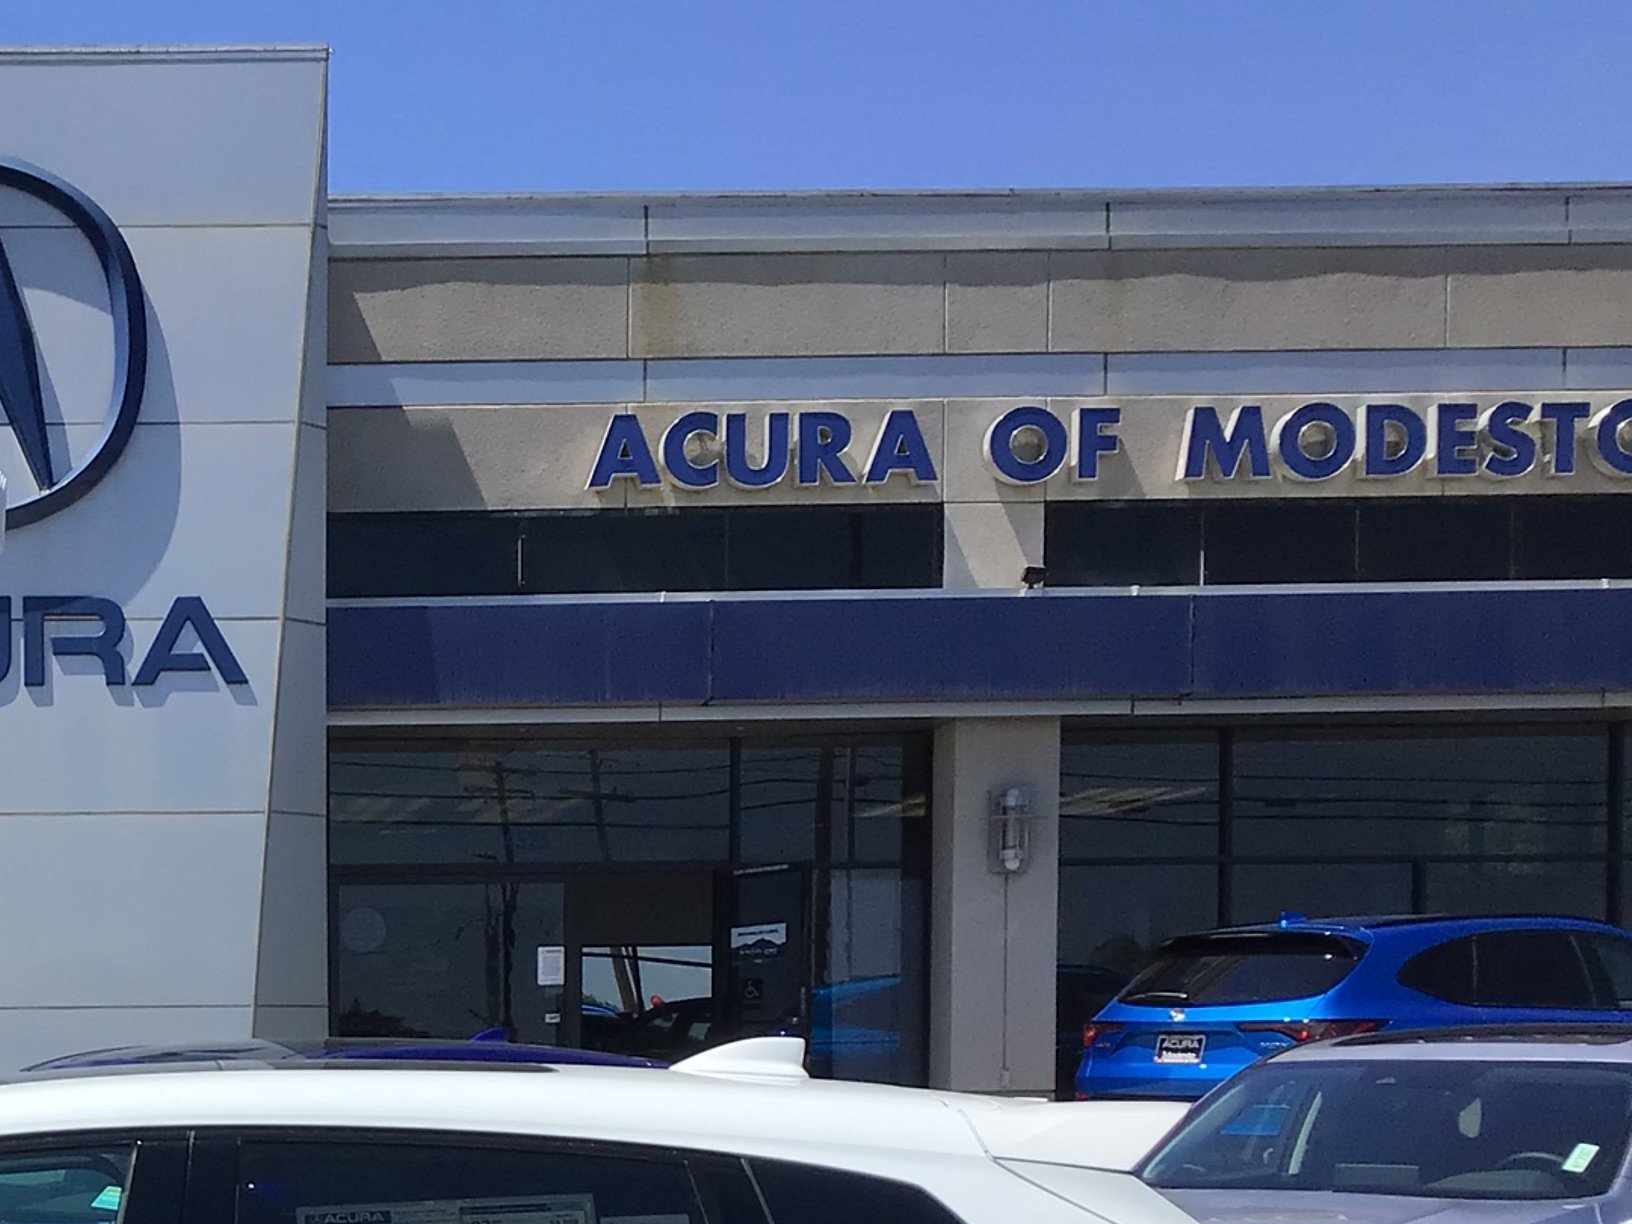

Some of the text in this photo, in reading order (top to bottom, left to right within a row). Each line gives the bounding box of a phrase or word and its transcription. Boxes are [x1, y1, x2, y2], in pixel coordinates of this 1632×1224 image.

[585, 409, 939, 490] ACURA
[984, 405, 1121, 483] OF
[1162, 1039, 1200, 1048] ACURA
[325, 1212, 385, 1224] ACURA
